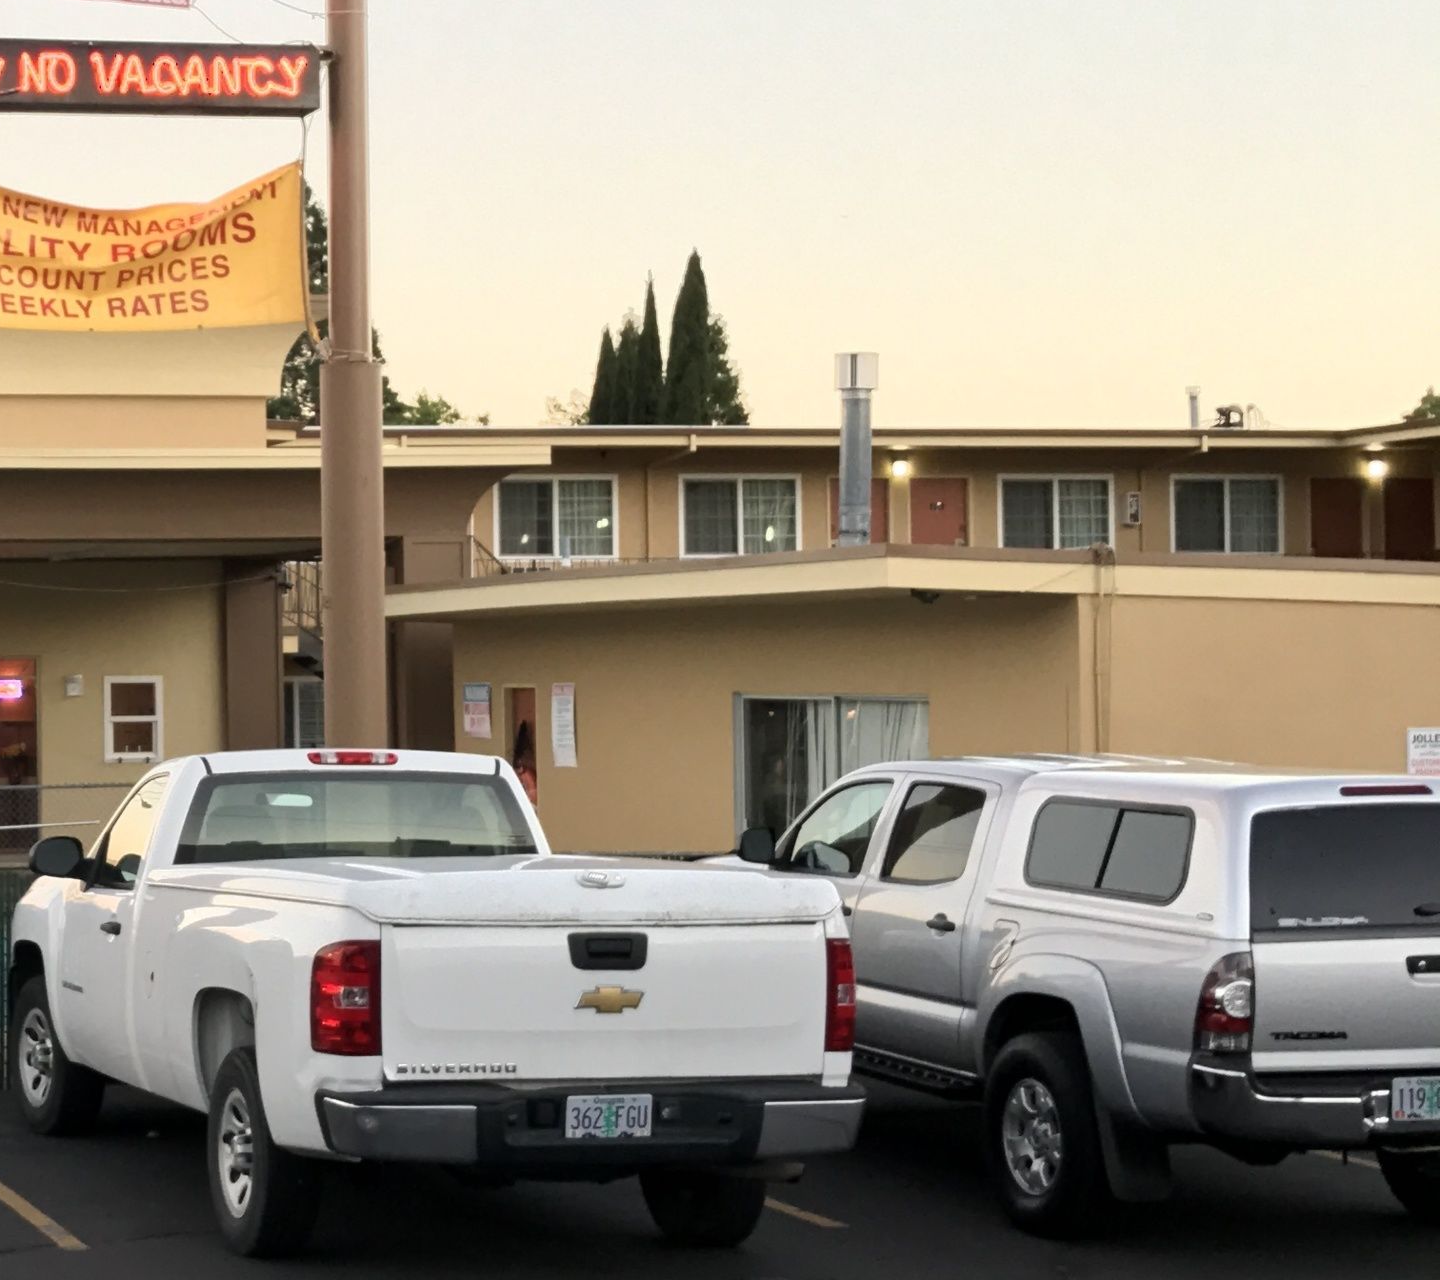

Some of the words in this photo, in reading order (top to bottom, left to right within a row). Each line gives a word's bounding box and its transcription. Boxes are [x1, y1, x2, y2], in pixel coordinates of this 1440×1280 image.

[20, 51, 75, 93] NO
[91, 53, 308, 97] VACANCY
[2, 195, 70, 228] NEW
[76, 176, 280, 237] MANAGENT
[110, 211, 257, 264] ROOMS
[115, 254, 231, 289] PRICES
[107, 288, 210, 318] RATES
[397, 1063, 517, 1073] SILVERADO
[571, 1106, 603, 1129] 362
[615, 1105, 648, 1128] FGU
